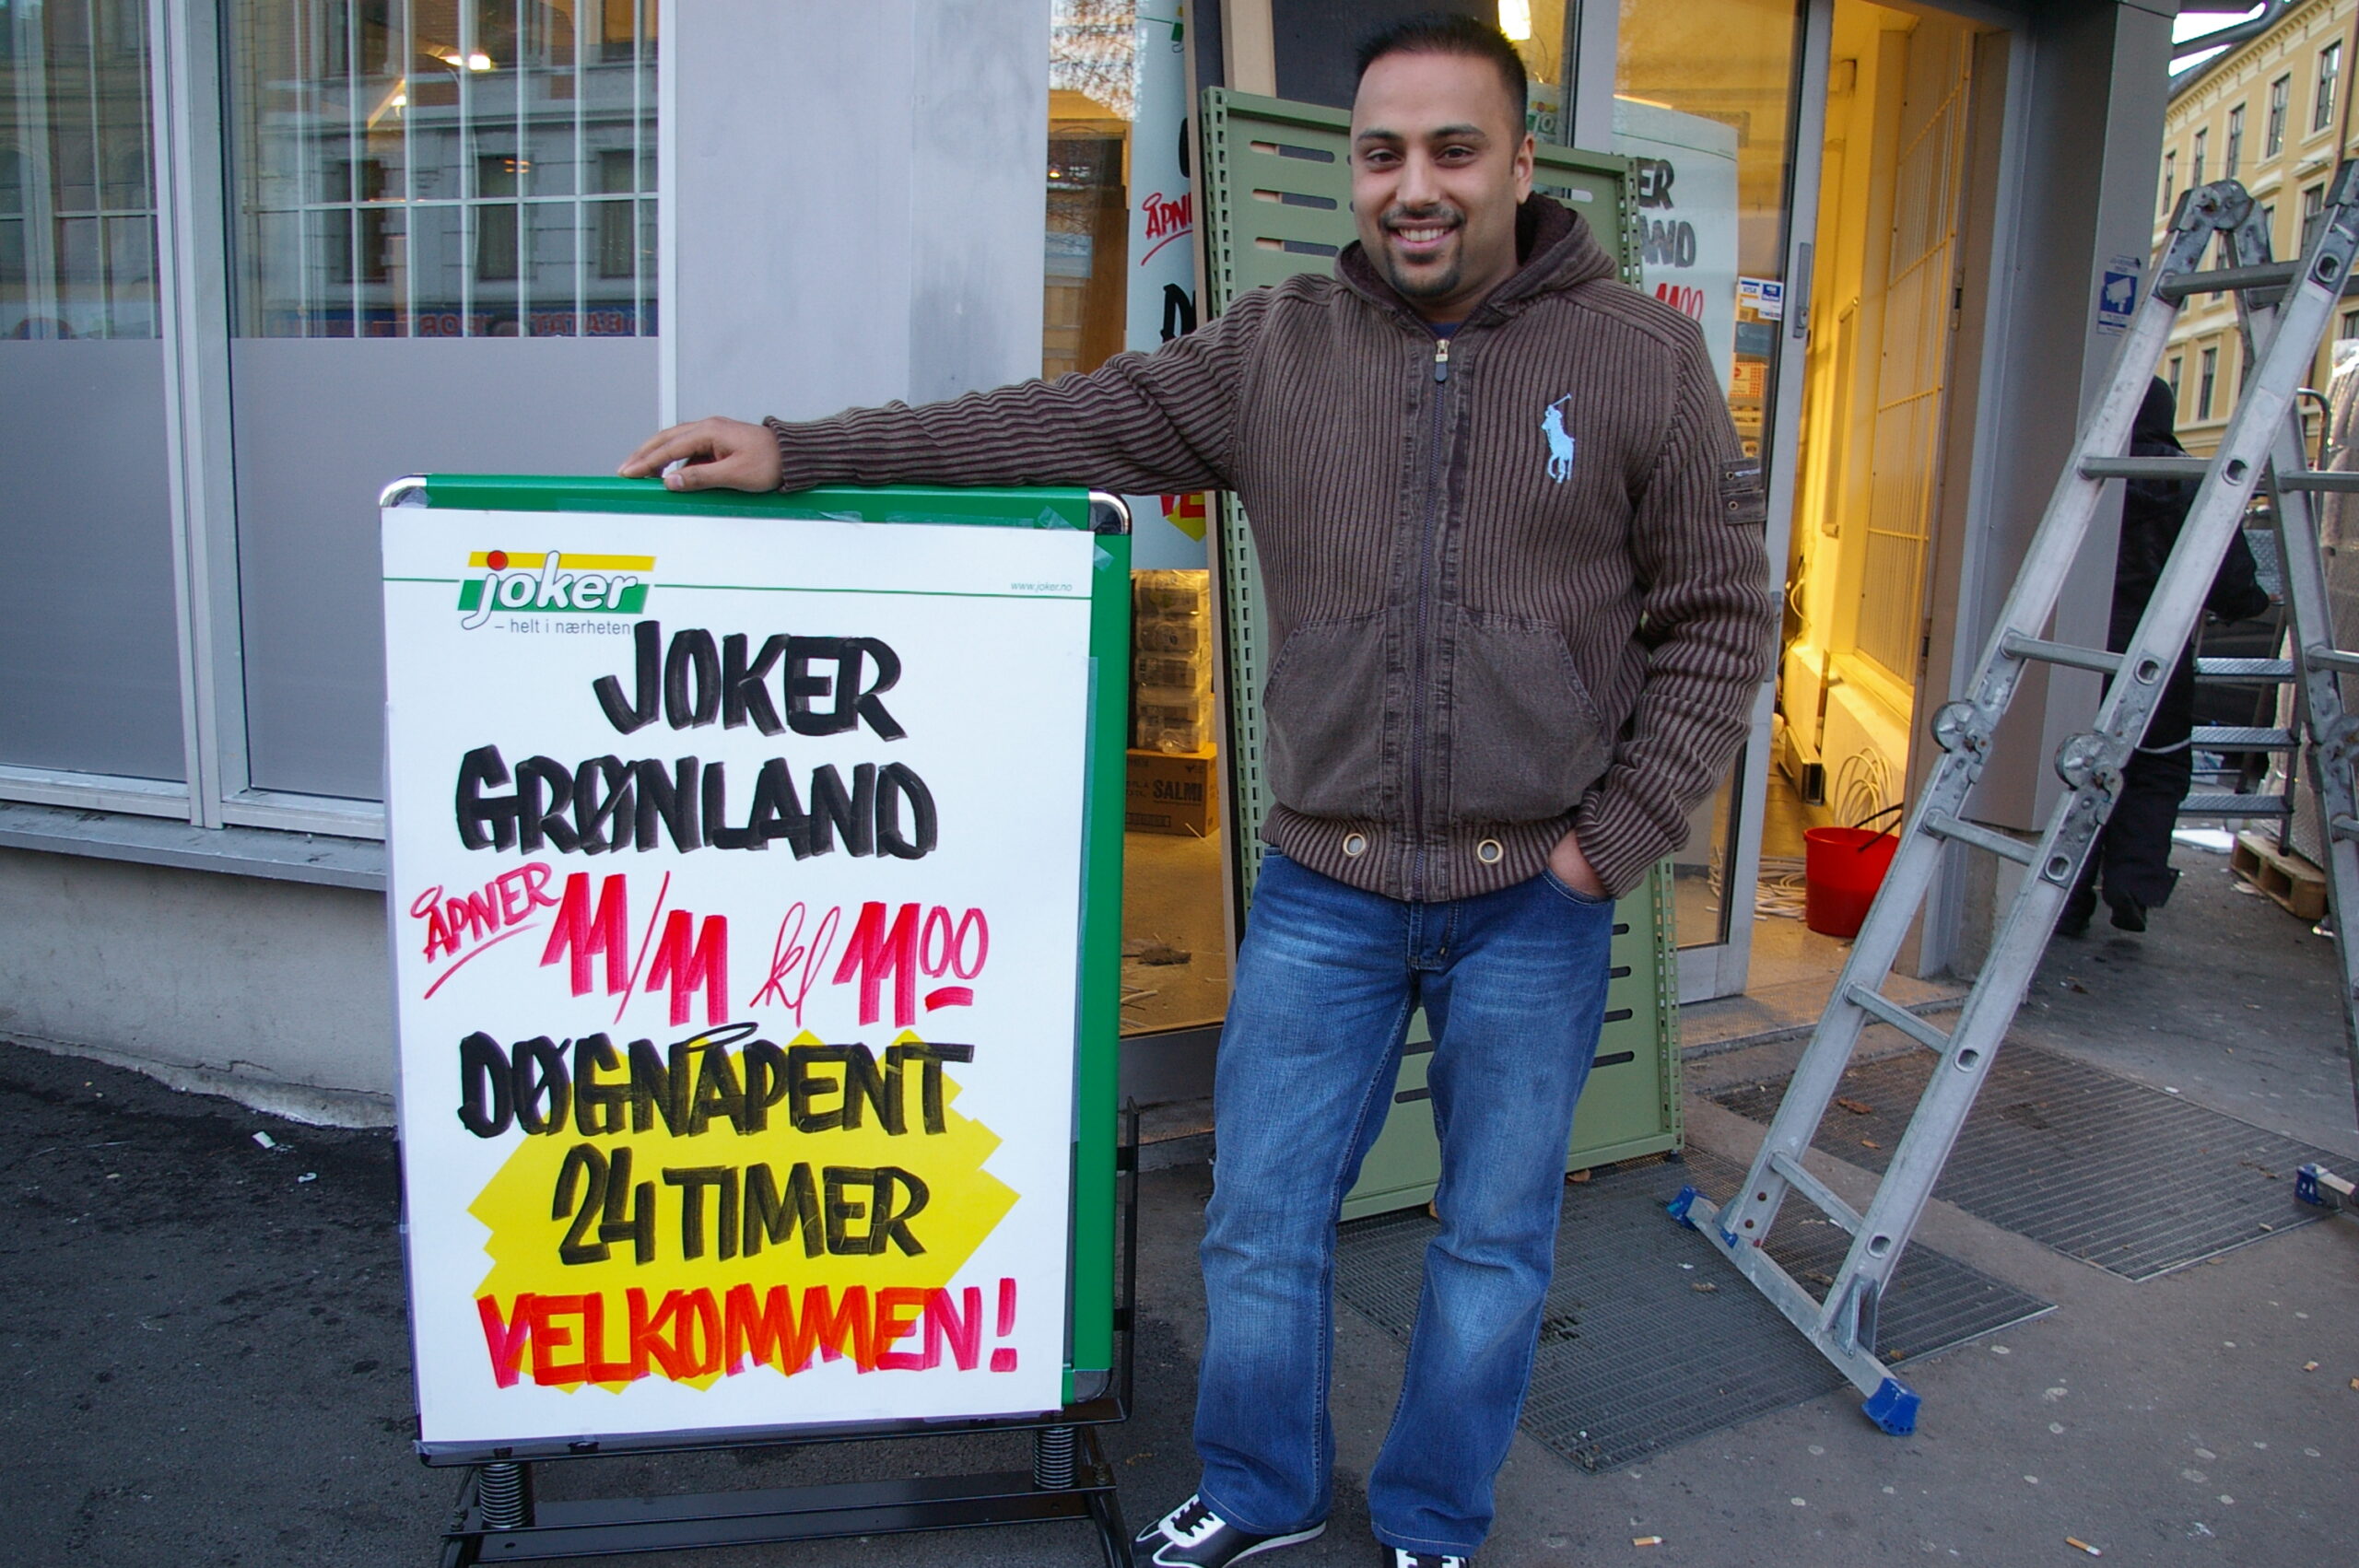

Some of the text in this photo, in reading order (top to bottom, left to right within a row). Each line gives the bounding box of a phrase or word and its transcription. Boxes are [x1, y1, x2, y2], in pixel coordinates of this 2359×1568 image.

[461, 550, 639, 630] joker
[511, 618, 540, 634] helt
[546, 618, 549, 634] i
[556, 620, 631, 635] nærheten
[1010, 581, 1074, 593] www.joker.no
[593, 620, 908, 741] JOKER
[455, 743, 938, 860] GRØNLAND
[410, 861, 561, 964] ÅPNER
[749, 901, 841, 1028] kl
[458, 1022, 976, 1139] DØGNÅPENT
[552, 1142, 932, 1267] 24 TIMER
[475, 1277, 1019, 1389] VELKOMMEN!
